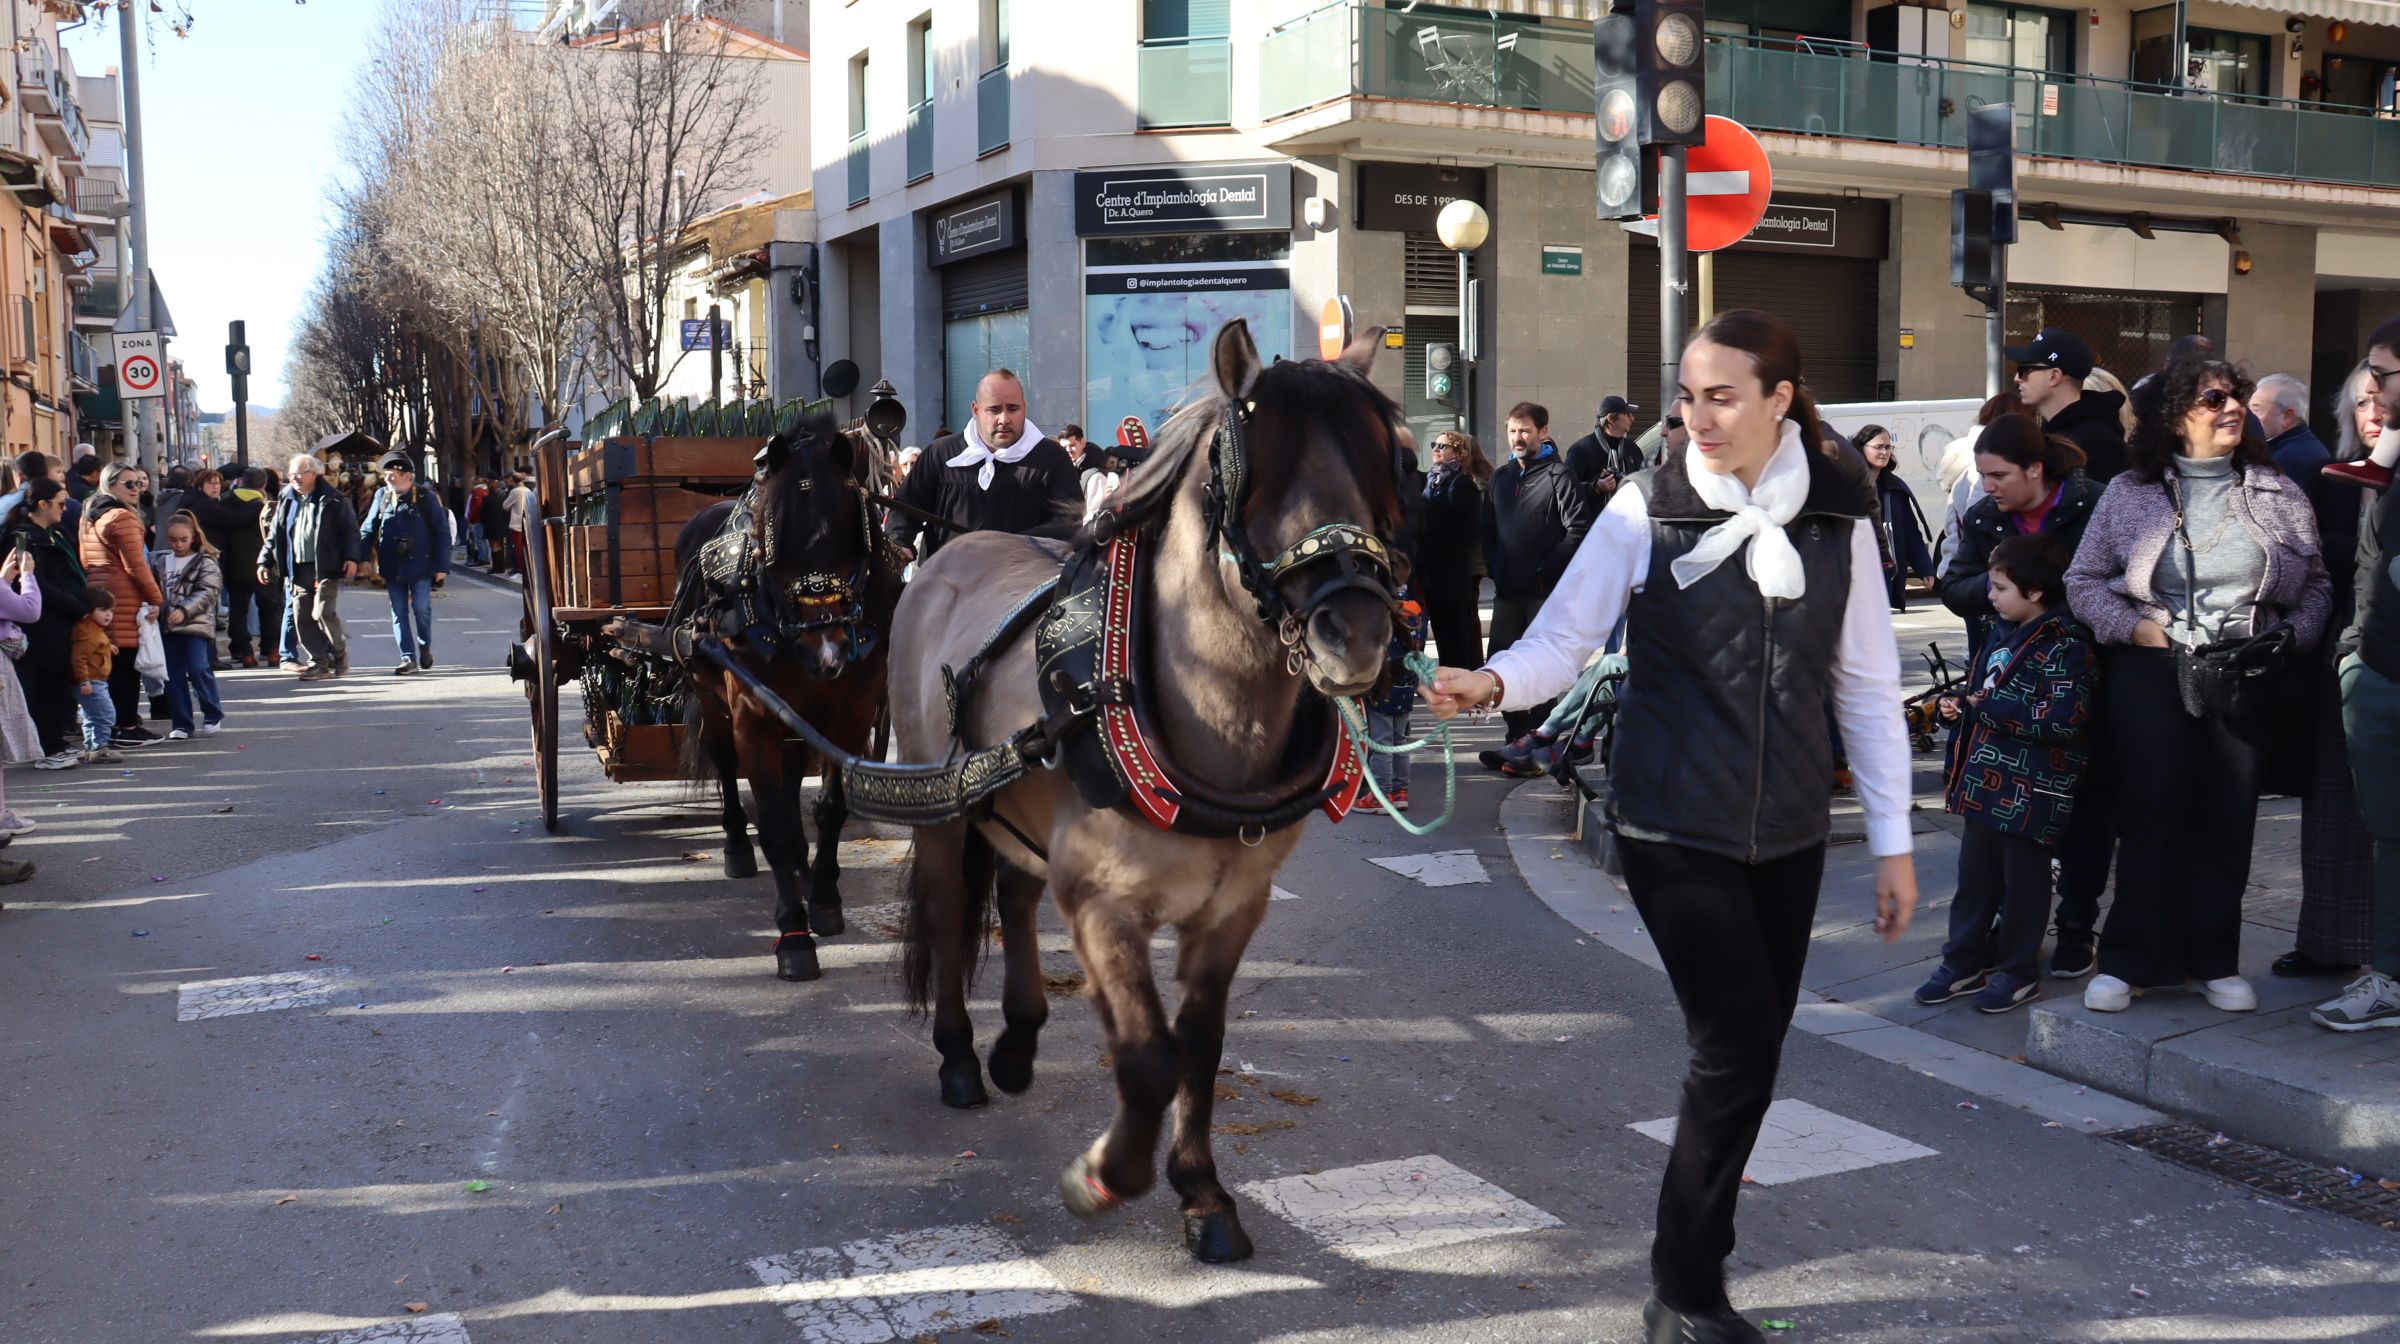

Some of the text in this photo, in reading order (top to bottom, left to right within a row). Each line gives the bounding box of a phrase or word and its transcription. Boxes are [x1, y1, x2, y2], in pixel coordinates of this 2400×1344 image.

[1096, 187, 1256, 208] Centre d'Implantología Dental
[1394, 194, 1413, 205] DES
[1415, 195, 1428, 206] DE
[1108, 208, 1120, 217] Dr.
[1755, 216, 1801, 232] plantología
[1802, 217, 1828, 232] Dental
[1139, 277, 1248, 289] @implantologiadentalquero
[121, 339, 152, 349] ZONA
[129, 366, 151, 379] 30
